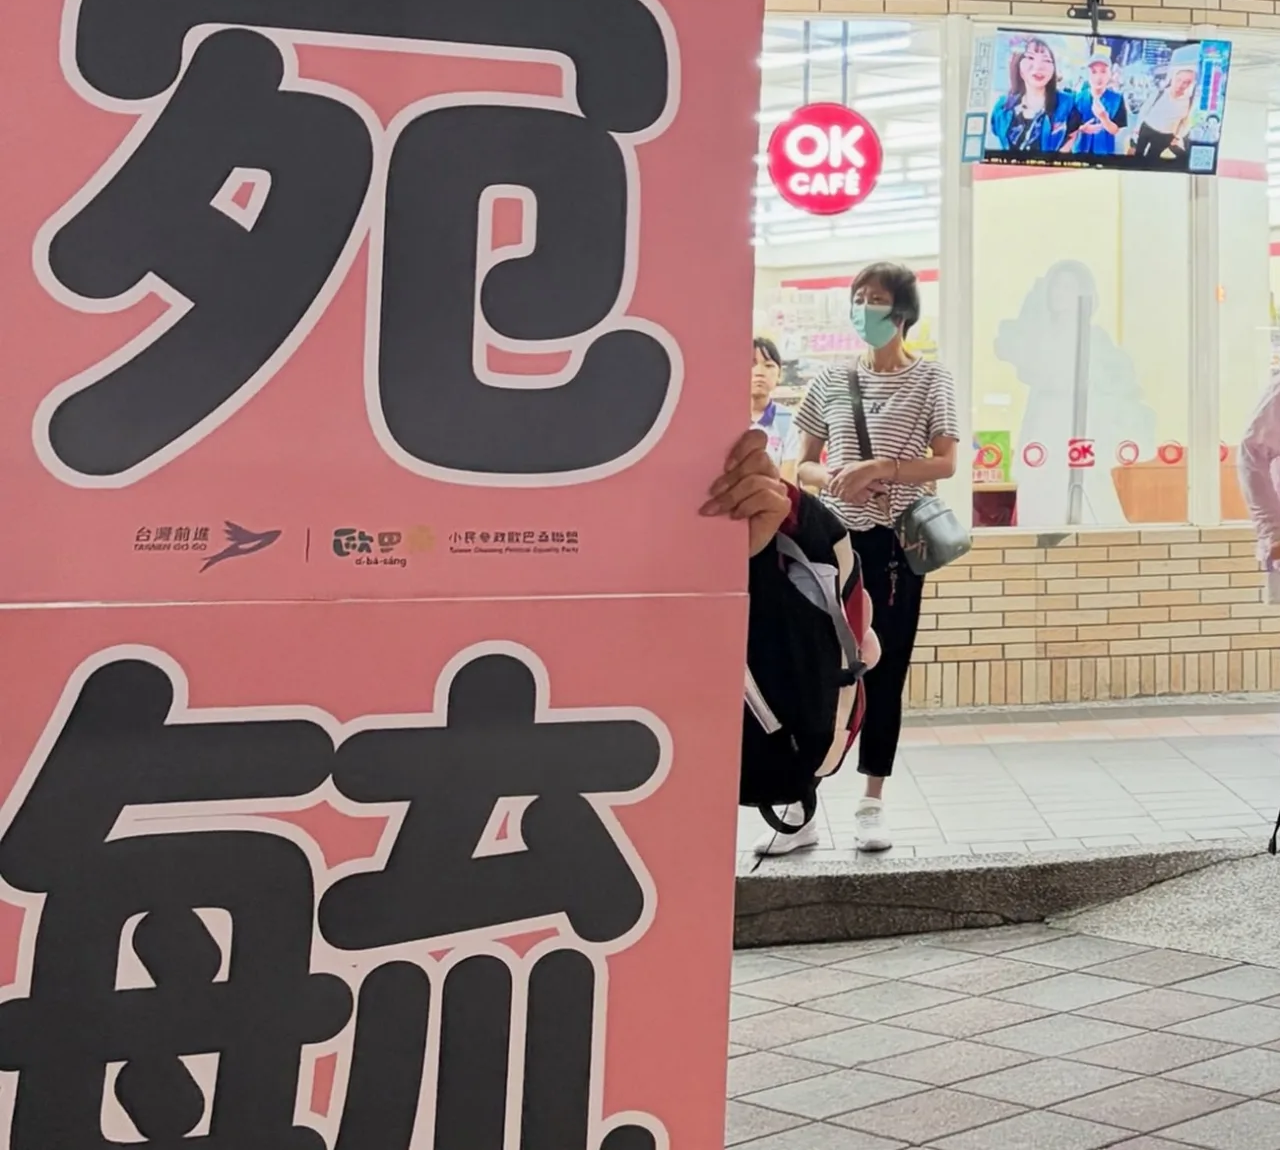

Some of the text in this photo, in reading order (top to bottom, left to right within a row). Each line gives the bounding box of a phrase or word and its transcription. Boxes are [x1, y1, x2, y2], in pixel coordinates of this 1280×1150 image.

[785, 124, 865, 169] OK
[788, 167, 861, 196] CAFÉ
[1067, 444, 1095, 462] OK
